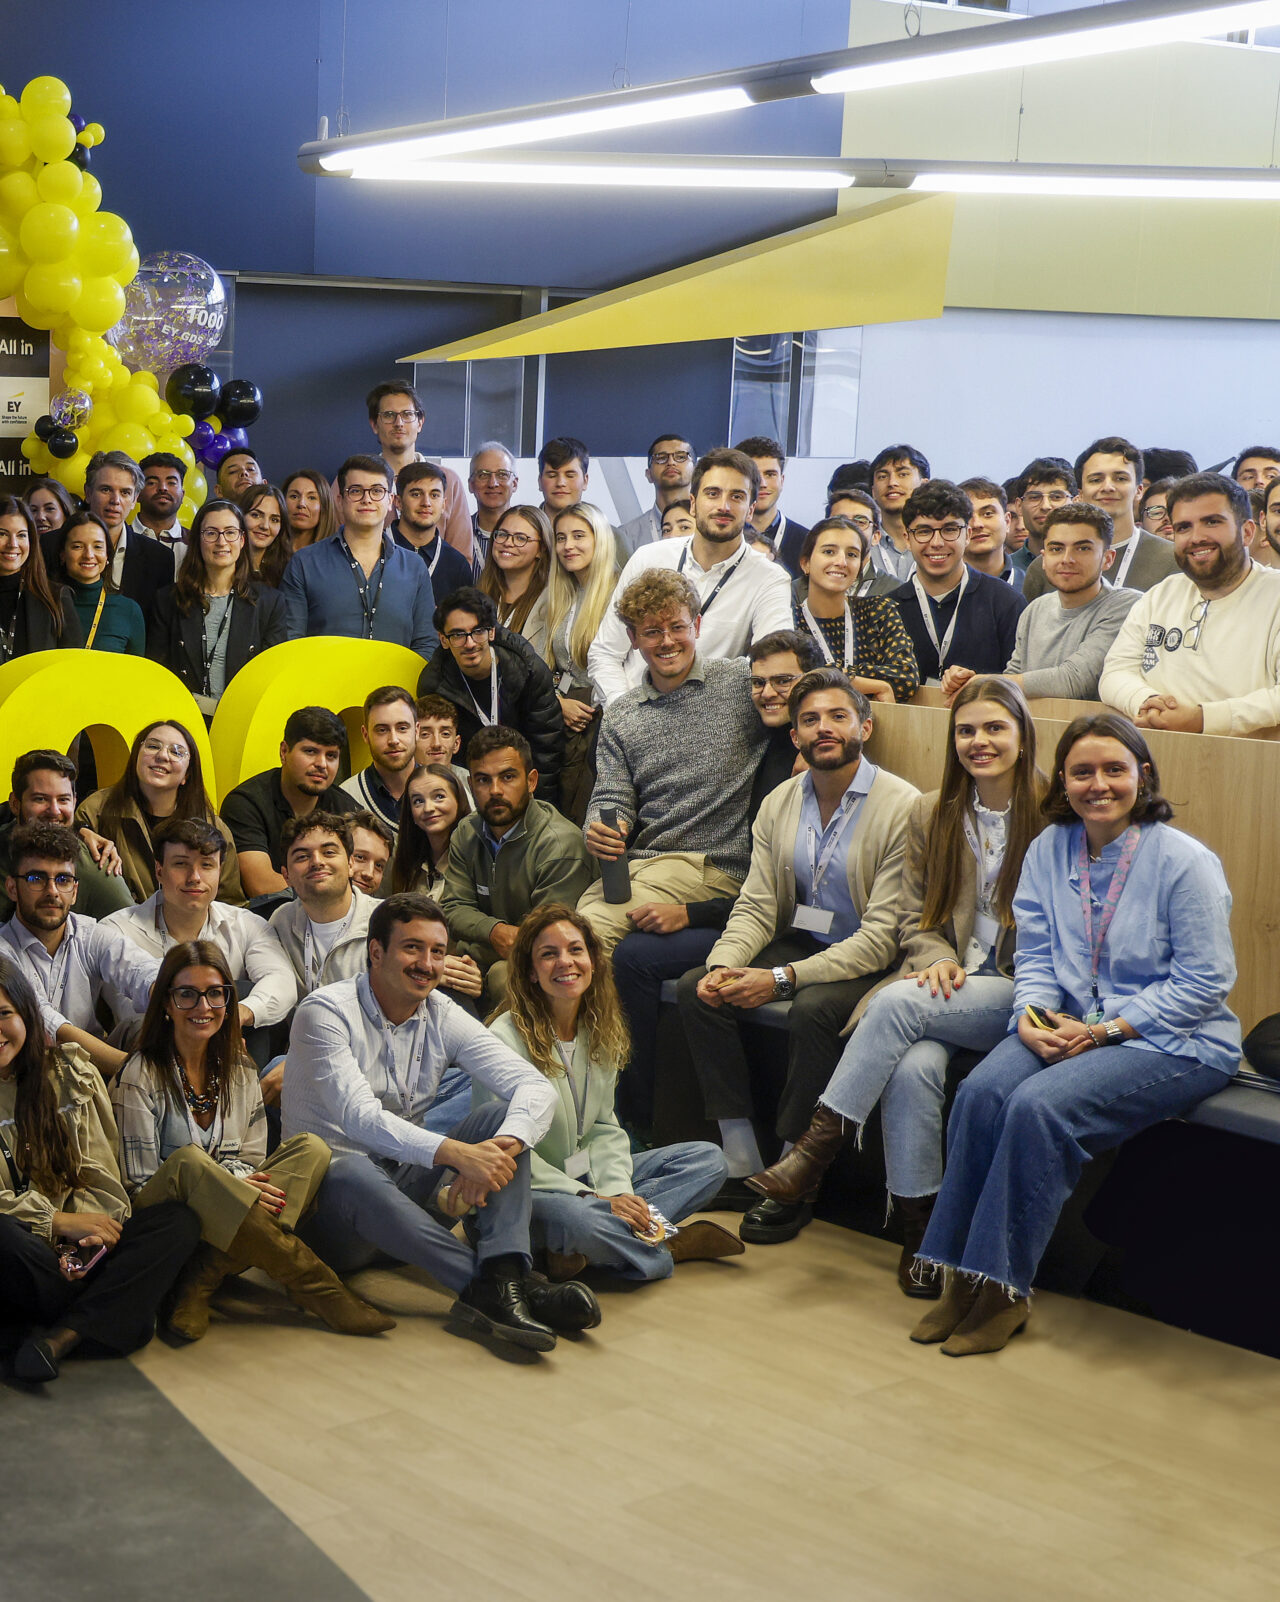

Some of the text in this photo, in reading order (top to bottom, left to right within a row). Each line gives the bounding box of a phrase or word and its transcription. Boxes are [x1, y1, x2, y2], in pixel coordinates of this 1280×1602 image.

[187, 308, 224, 330] 1000
[161, 324, 179, 336] EY
[181, 332, 204, 345] GDS
[21, 339, 33, 355] in
[7, 401, 21, 412] EY
[19, 460, 31, 475] in
